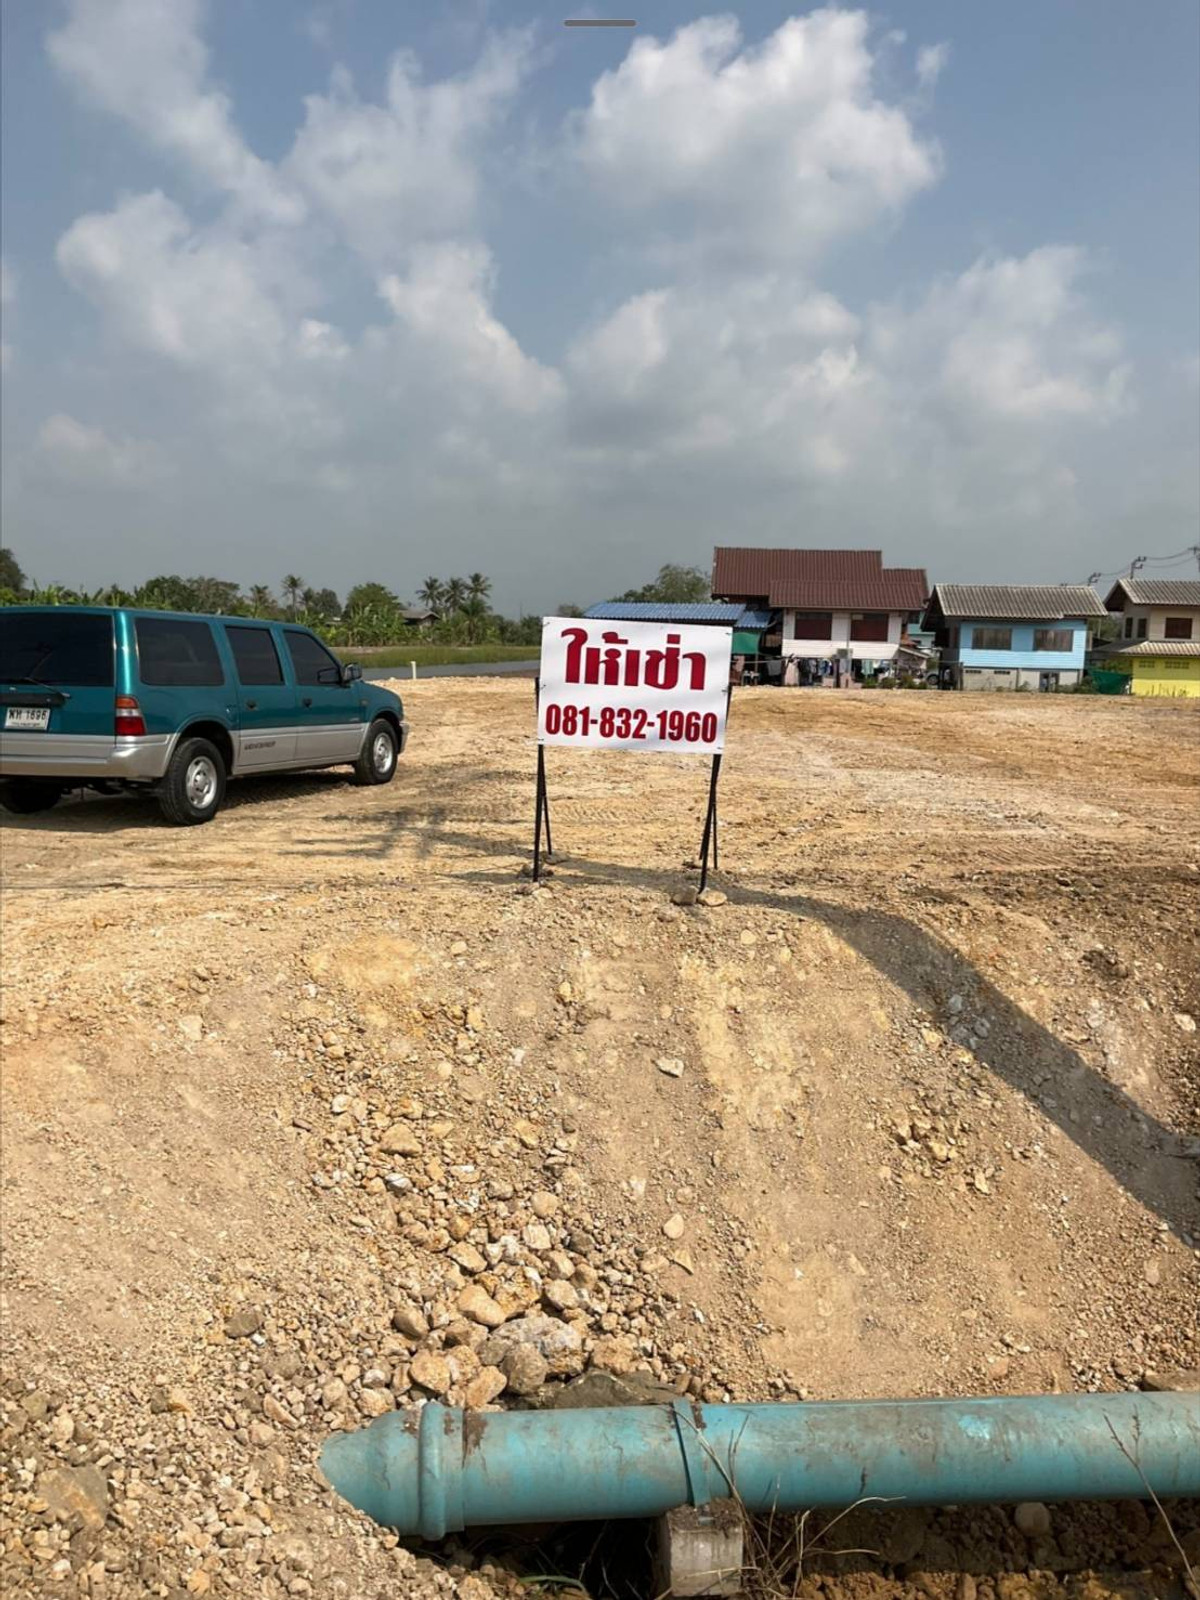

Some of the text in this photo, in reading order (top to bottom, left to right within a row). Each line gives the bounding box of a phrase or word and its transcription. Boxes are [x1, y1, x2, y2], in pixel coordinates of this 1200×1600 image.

[561, 627, 706, 690] ให้เช่า
[545, 703, 718, 743] 081-832-1960
